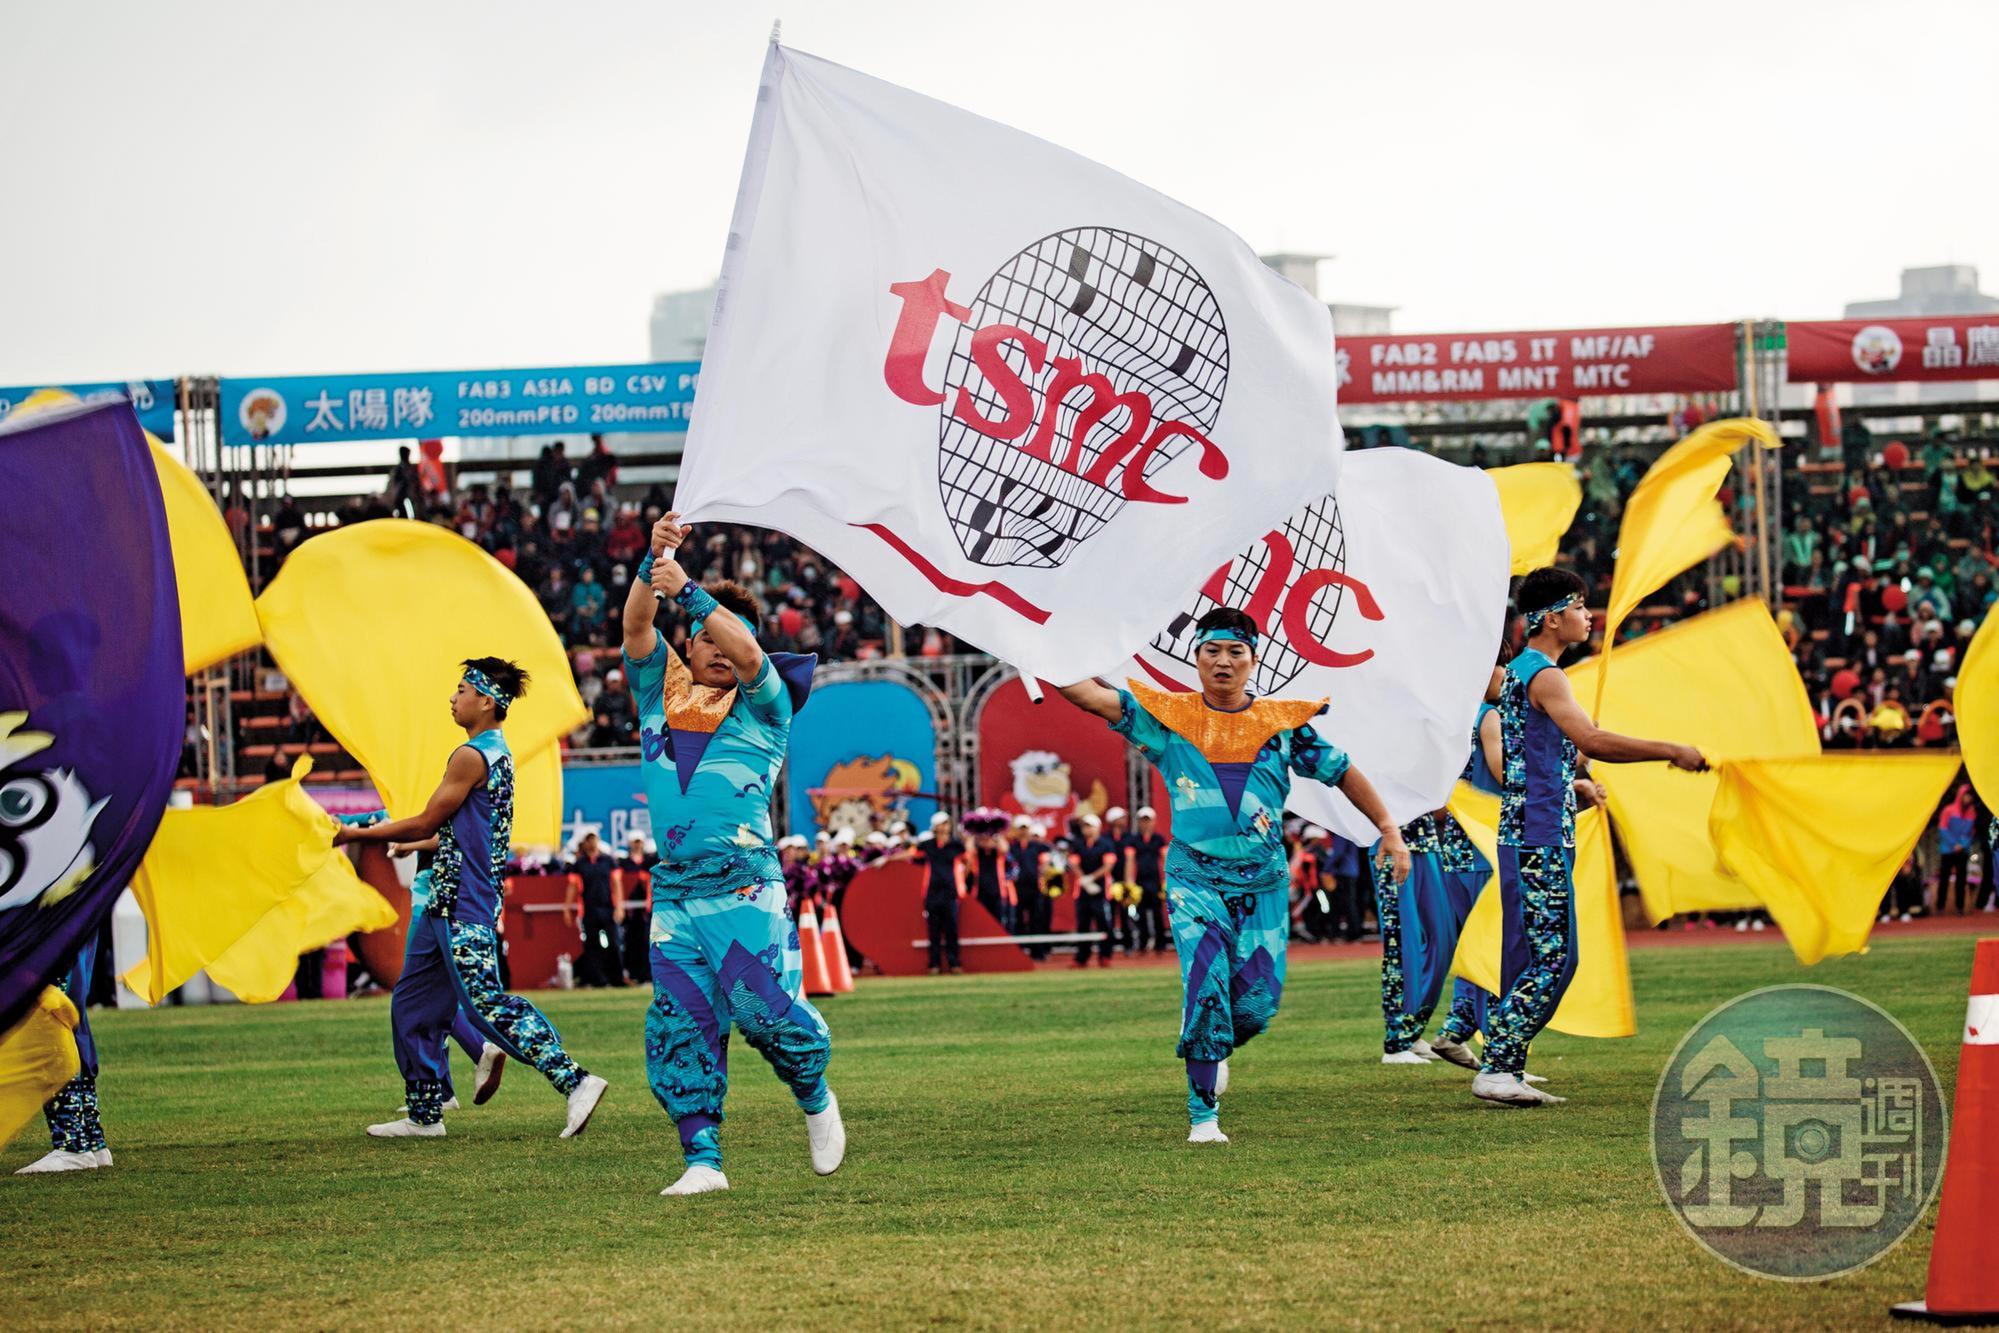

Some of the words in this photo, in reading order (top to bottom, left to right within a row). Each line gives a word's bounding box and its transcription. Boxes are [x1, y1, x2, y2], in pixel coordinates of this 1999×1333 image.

[1370, 342, 1437, 366] FAB2
[1530, 337, 1556, 362] IT
[1570, 334, 1655, 360] MF/AF
[458, 379, 512, 399] FAB3
[523, 377, 574, 397] ASIA
[626, 374, 667, 393] CSV
[884, 268, 1229, 505] tsmc
[1371, 368, 1484, 394] MM&RM
[1497, 365, 1560, 391] MNT
[1573, 363, 1631, 388] MTC
[304, 385, 434, 433] 太陽隊
[458, 405, 579, 429] 200mmPED
